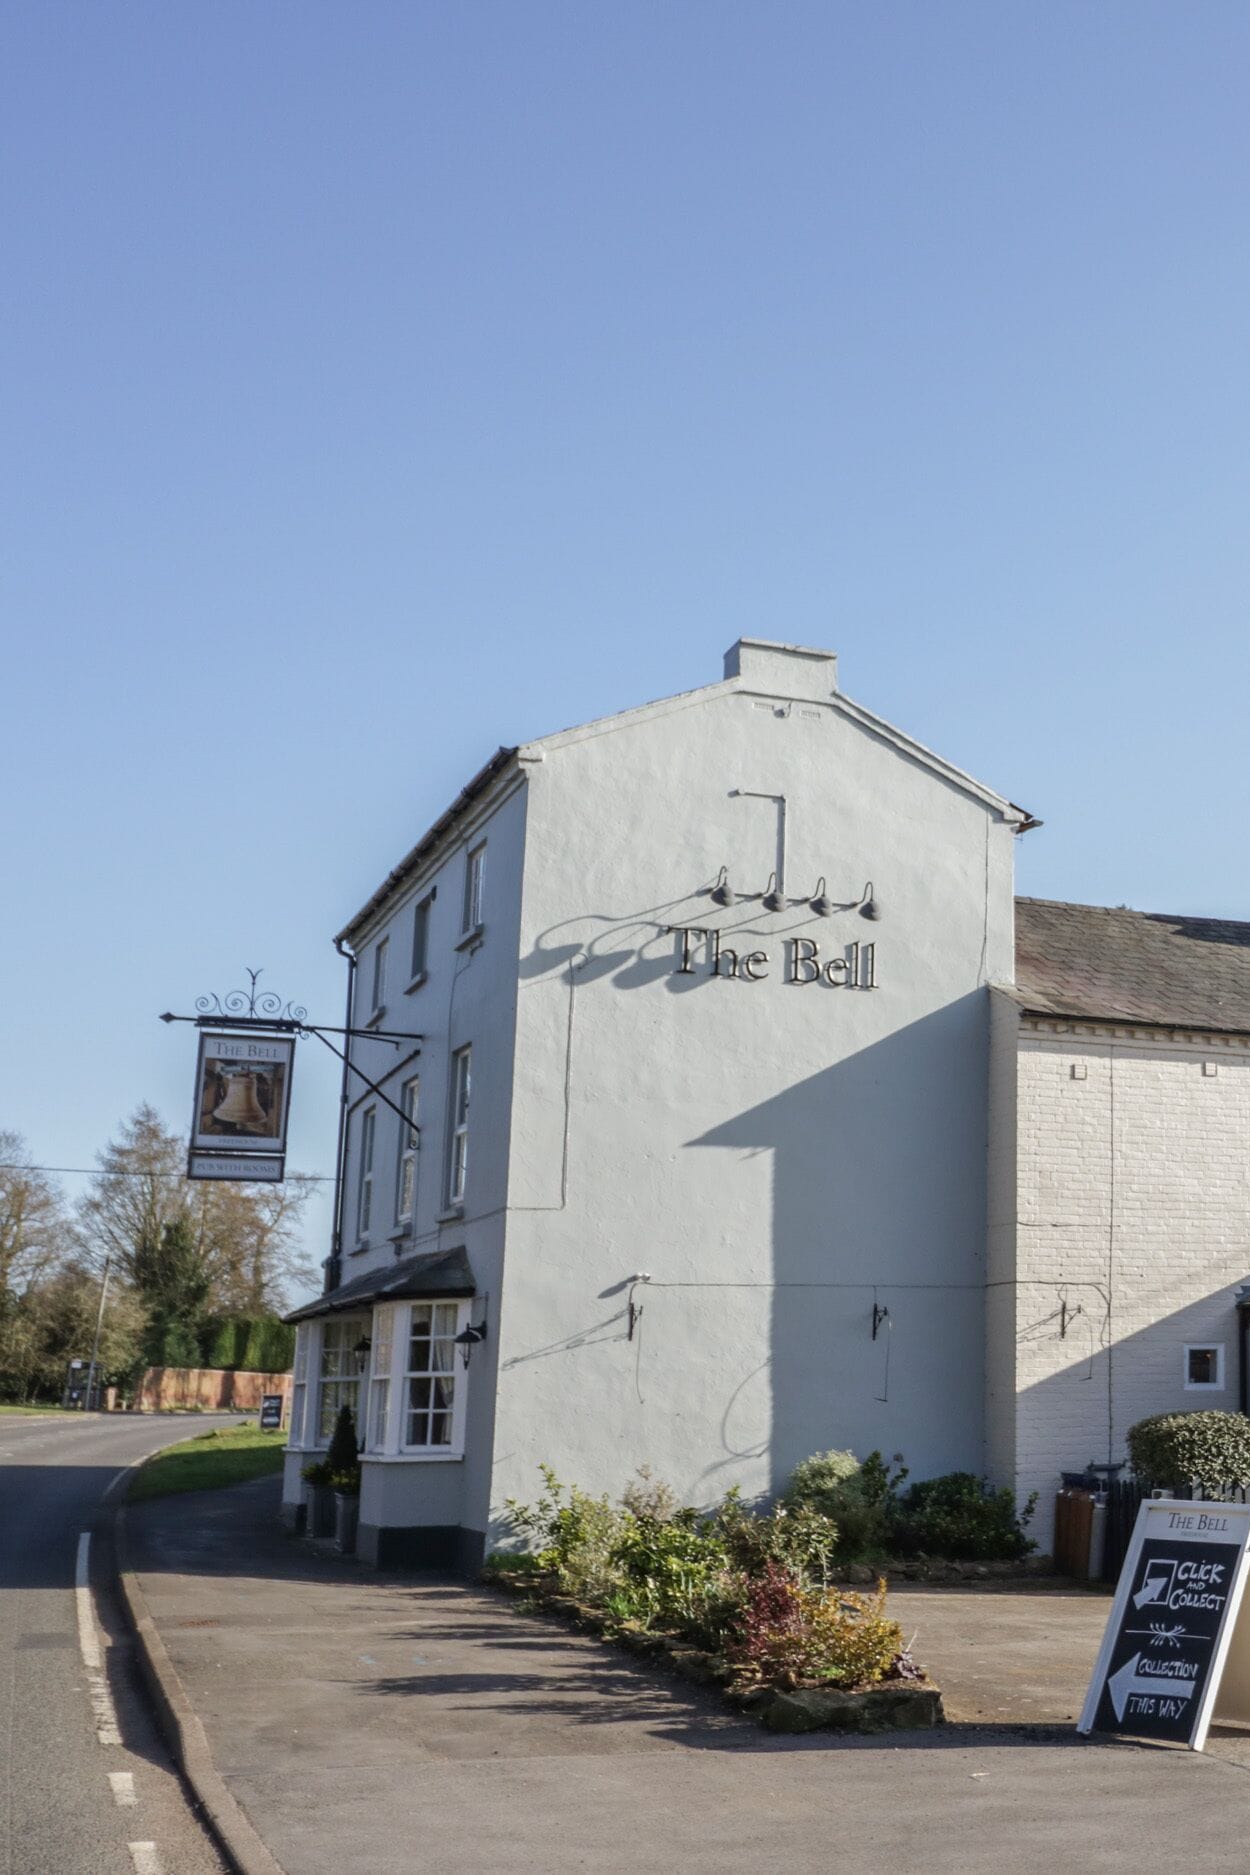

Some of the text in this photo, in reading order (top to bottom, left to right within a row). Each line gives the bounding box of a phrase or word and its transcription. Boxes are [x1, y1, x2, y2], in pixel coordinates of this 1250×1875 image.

[666, 925, 879, 989] The Bell
[213, 1041, 278, 1058] THE BELL
[1168, 1512, 1229, 1531] THE BELL
[1186, 1581, 1205, 1590] AND
[1169, 1589, 1225, 1610] COLLECT
[1130, 1696, 1188, 1720] THIS WAY
